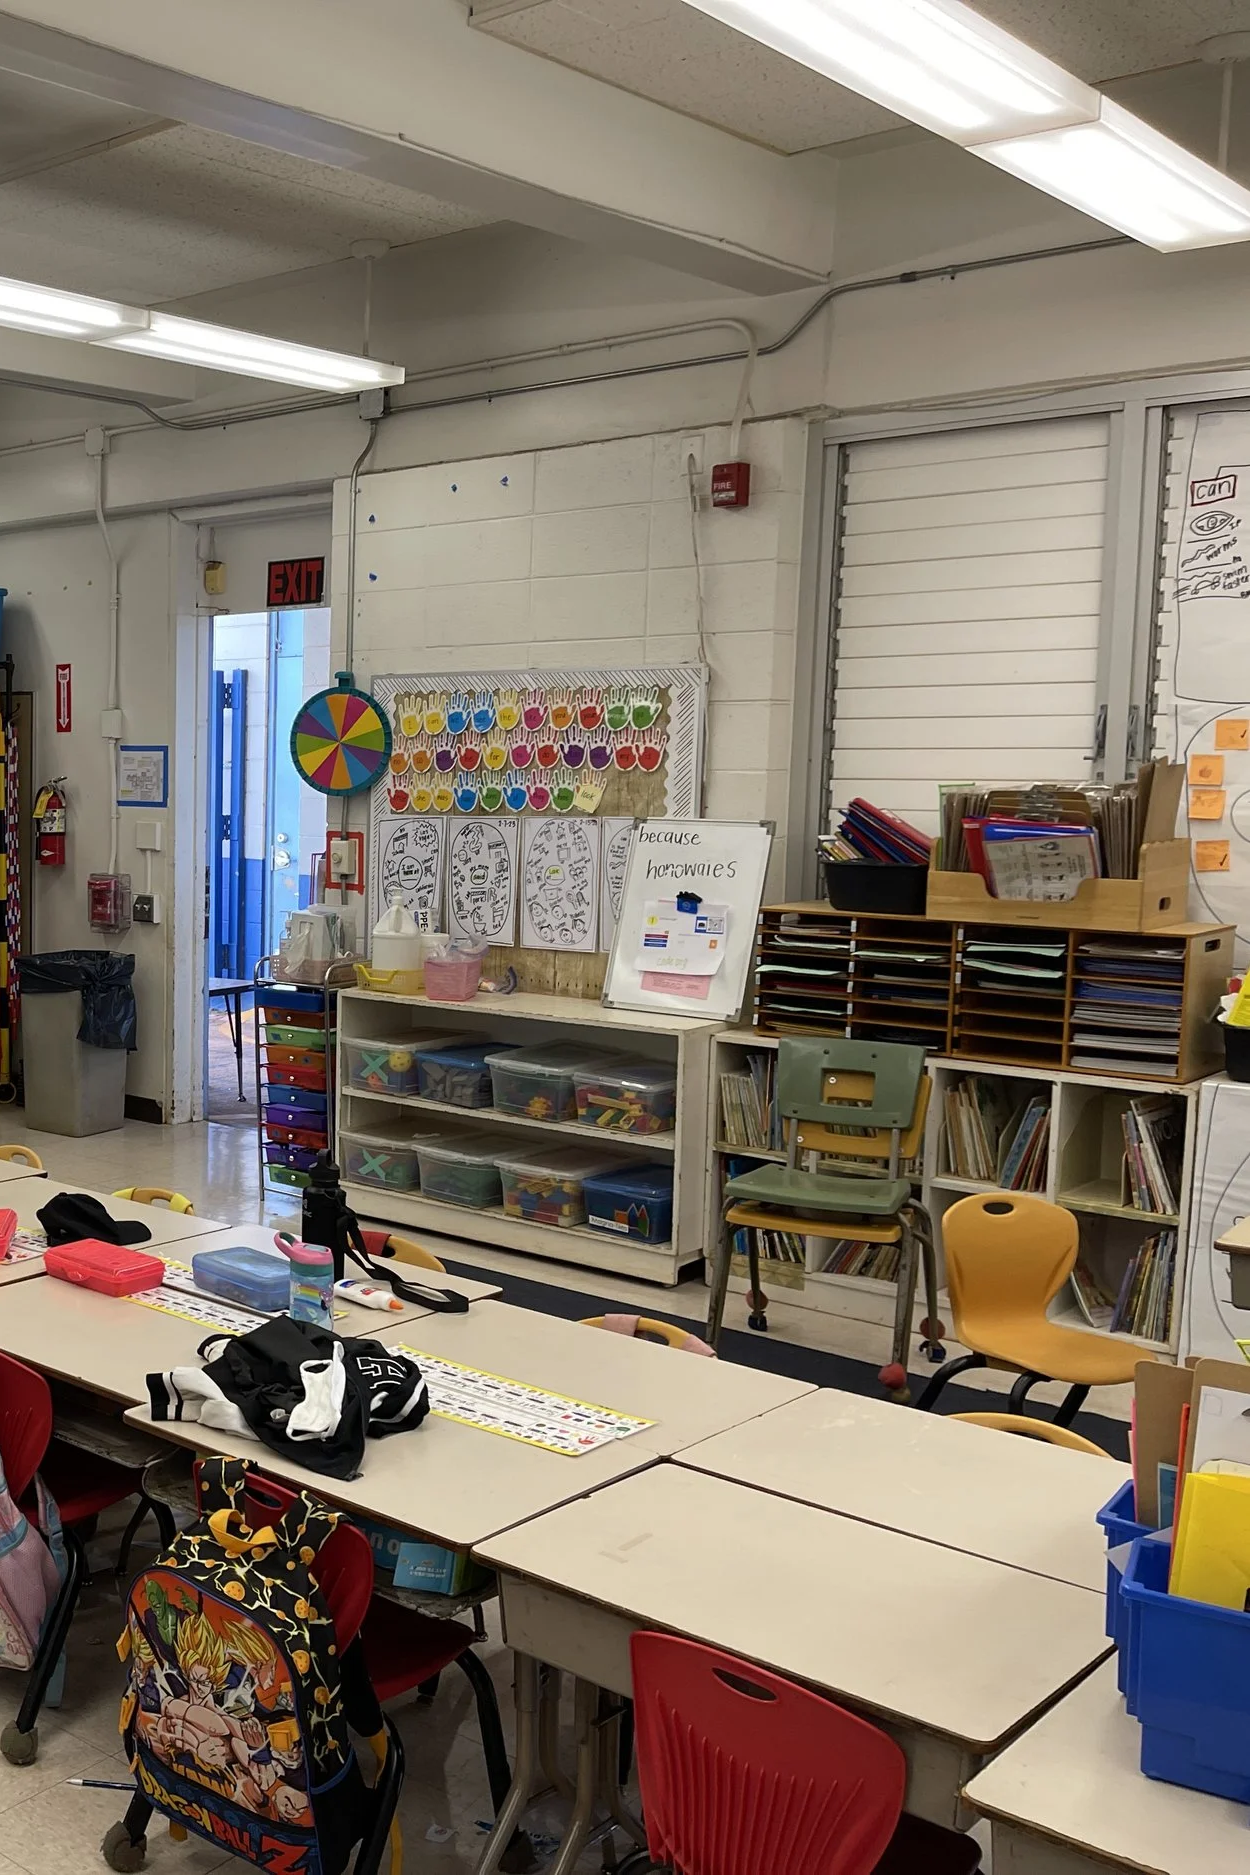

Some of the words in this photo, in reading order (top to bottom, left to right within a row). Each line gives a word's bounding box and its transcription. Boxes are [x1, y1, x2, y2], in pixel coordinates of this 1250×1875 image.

[713, 482, 732, 490] FIRE
[1196, 481, 1231, 499] can
[271, 563, 322, 601] EXIT
[490, 752, 499, 761] for
[581, 791, 594, 800] look
[639, 826, 701, 845] because
[137, 1754, 213, 1833] DRAGON
[209, 1812, 257, 1861] BALL
[261, 1835, 310, 1875] Z
